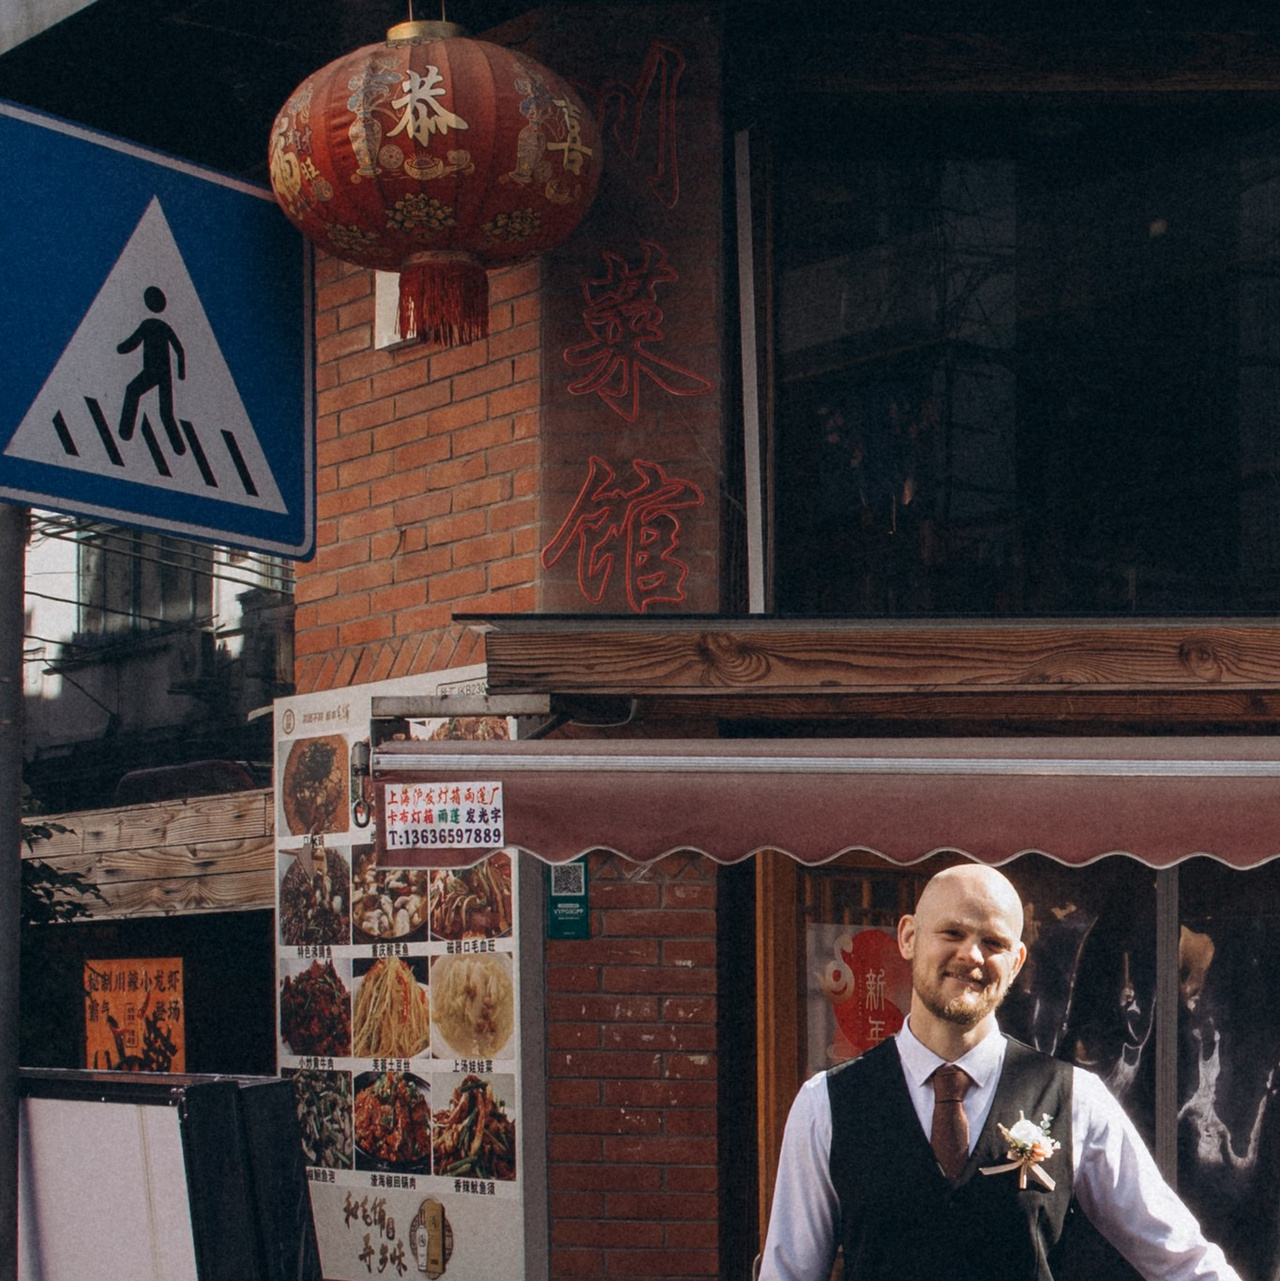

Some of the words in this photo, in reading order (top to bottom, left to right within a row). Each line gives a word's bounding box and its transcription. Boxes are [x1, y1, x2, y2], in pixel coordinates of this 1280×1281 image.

[465, 806, 502, 825] 发光字
[388, 827, 502, 846] T:13636597889
